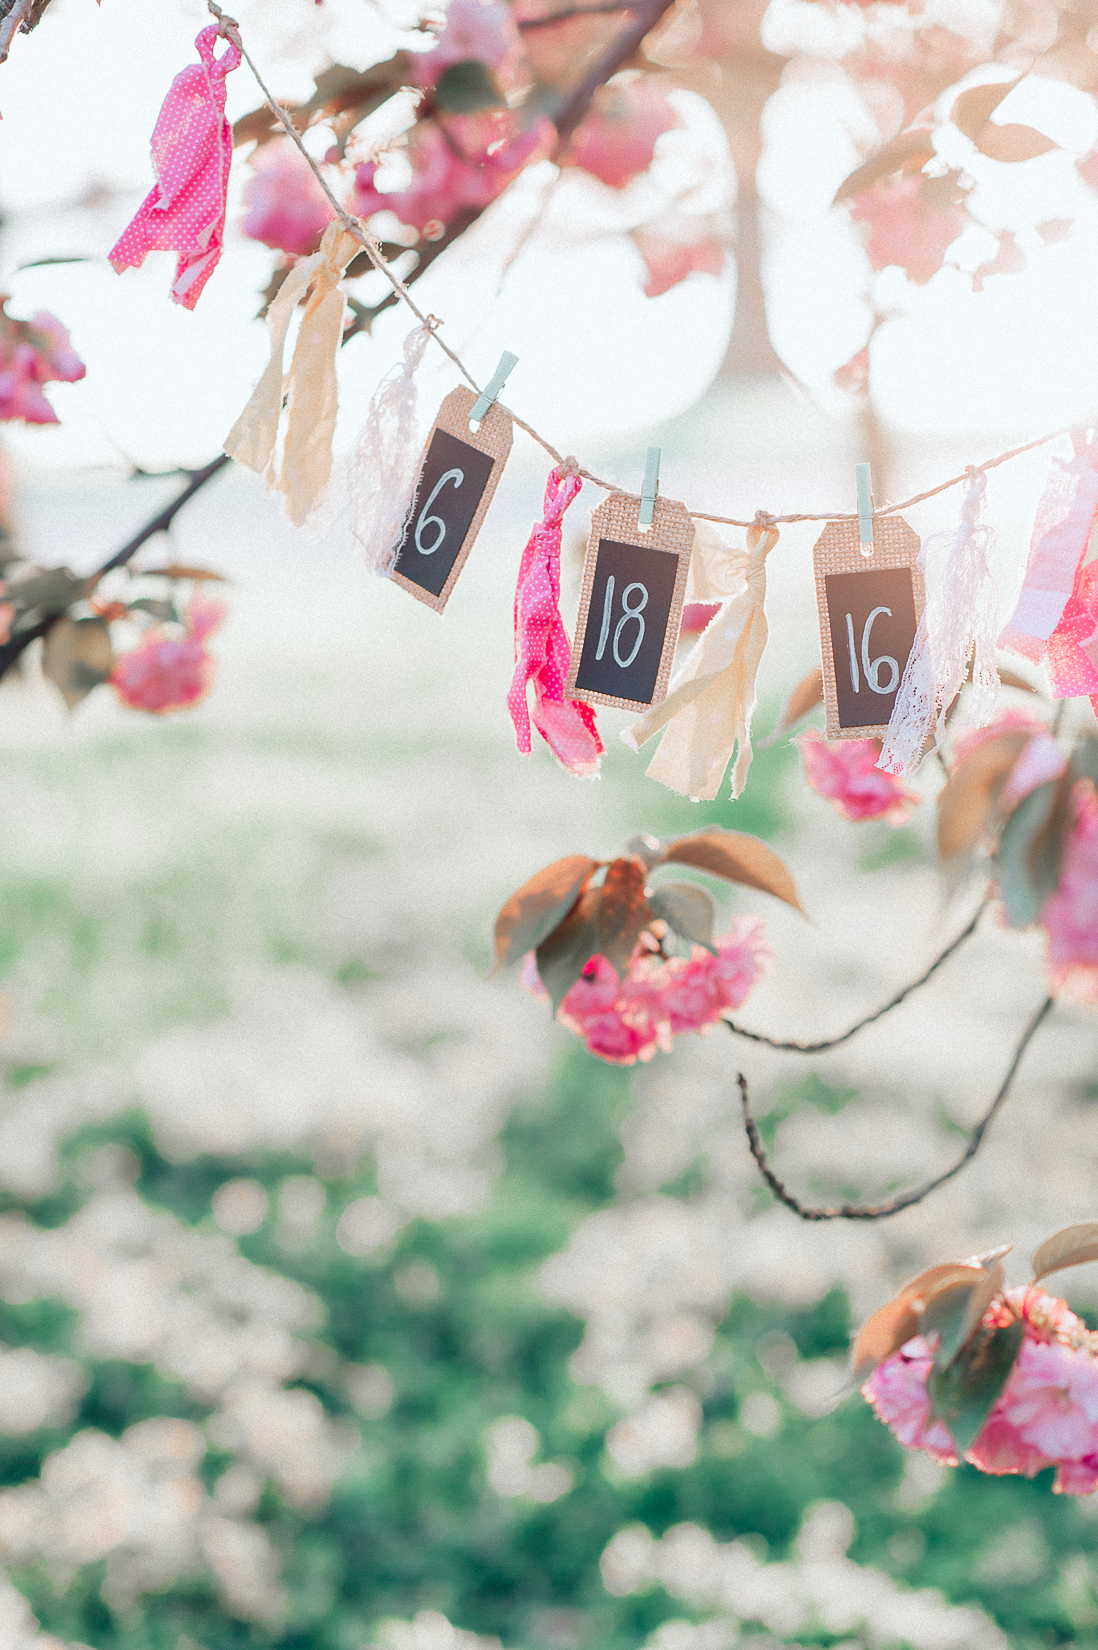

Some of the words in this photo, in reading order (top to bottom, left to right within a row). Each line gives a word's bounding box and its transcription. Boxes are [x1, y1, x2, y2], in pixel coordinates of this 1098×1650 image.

[414, 468, 464, 555] 6
[595, 575, 649, 669] 18
[845, 606, 900, 695] 16
